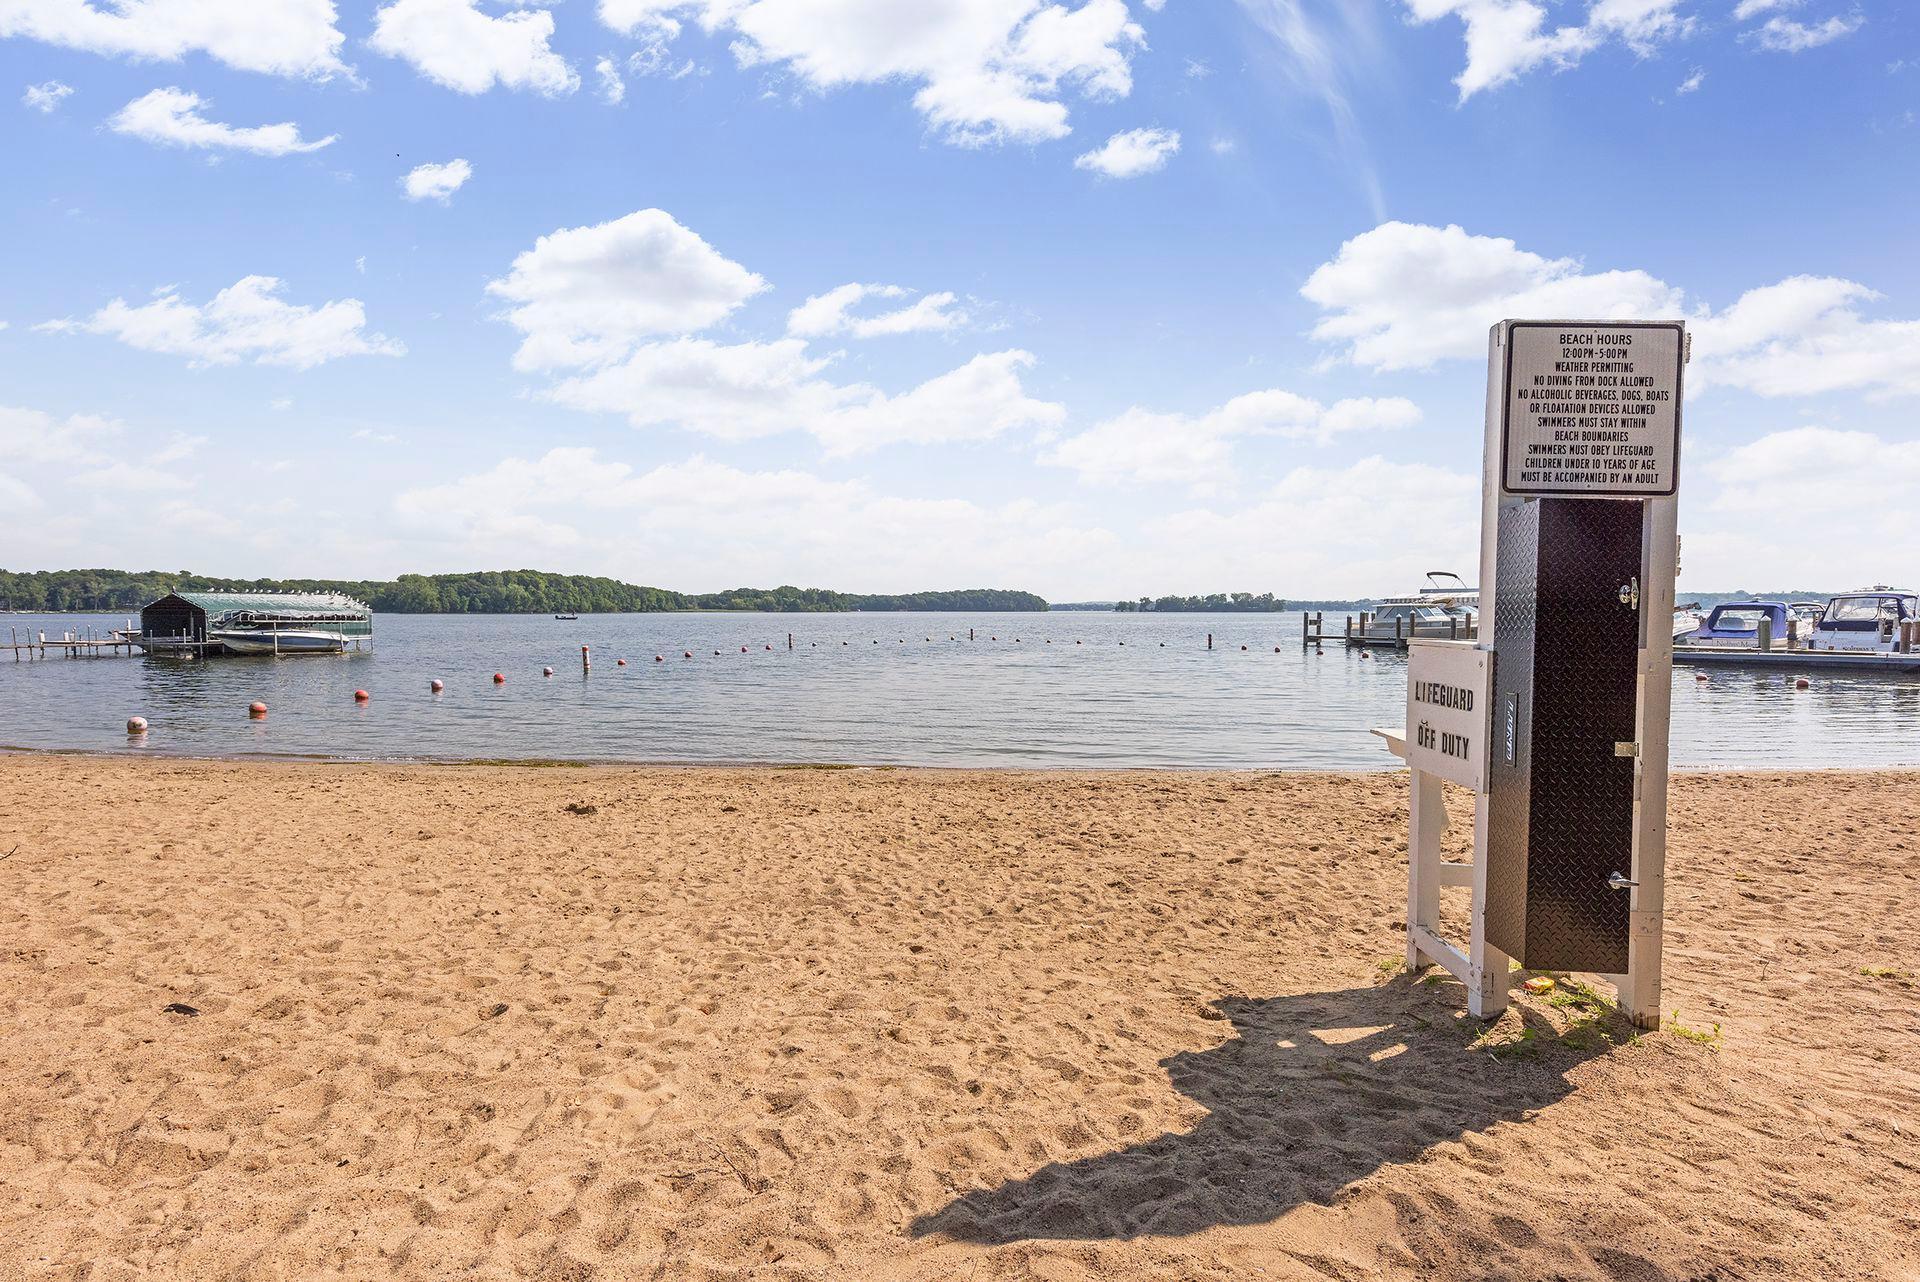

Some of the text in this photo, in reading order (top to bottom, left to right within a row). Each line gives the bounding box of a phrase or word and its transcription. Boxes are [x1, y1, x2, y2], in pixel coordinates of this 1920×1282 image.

[1559, 334, 1632, 345] BEACH HOURS
[1555, 362, 1634, 372] WEATHER PERMITTING
[1534, 376, 1654, 387] NO DIVING FROM DOCK ALLOWED
[1518, 389, 1529, 399] NO
[1530, 389, 1573, 399] ALCOHOLIC
[1646, 391, 1669, 401] BOATS
[1529, 403, 1656, 414] OR FLOATATION DEVICES ALLOWED
[1537, 417, 1647, 428] SWIMMERS MUST STAY WITHIN
[1554, 431, 1629, 442] BEACH BOUNDARIES
[1528, 444, 1654, 456] SWIMMERS MUST OBEY LIFEGUARD
[1525, 458, 1656, 470] CHILDREN UNDER 10 YEARS OF AGE
[1521, 472, 1659, 484] MUST BE ACCOMPANIED BY AN ADULT
[1416, 682, 1473, 711] LIFEGUARD
[1417, 725, 1470, 760] OFF DUTY
